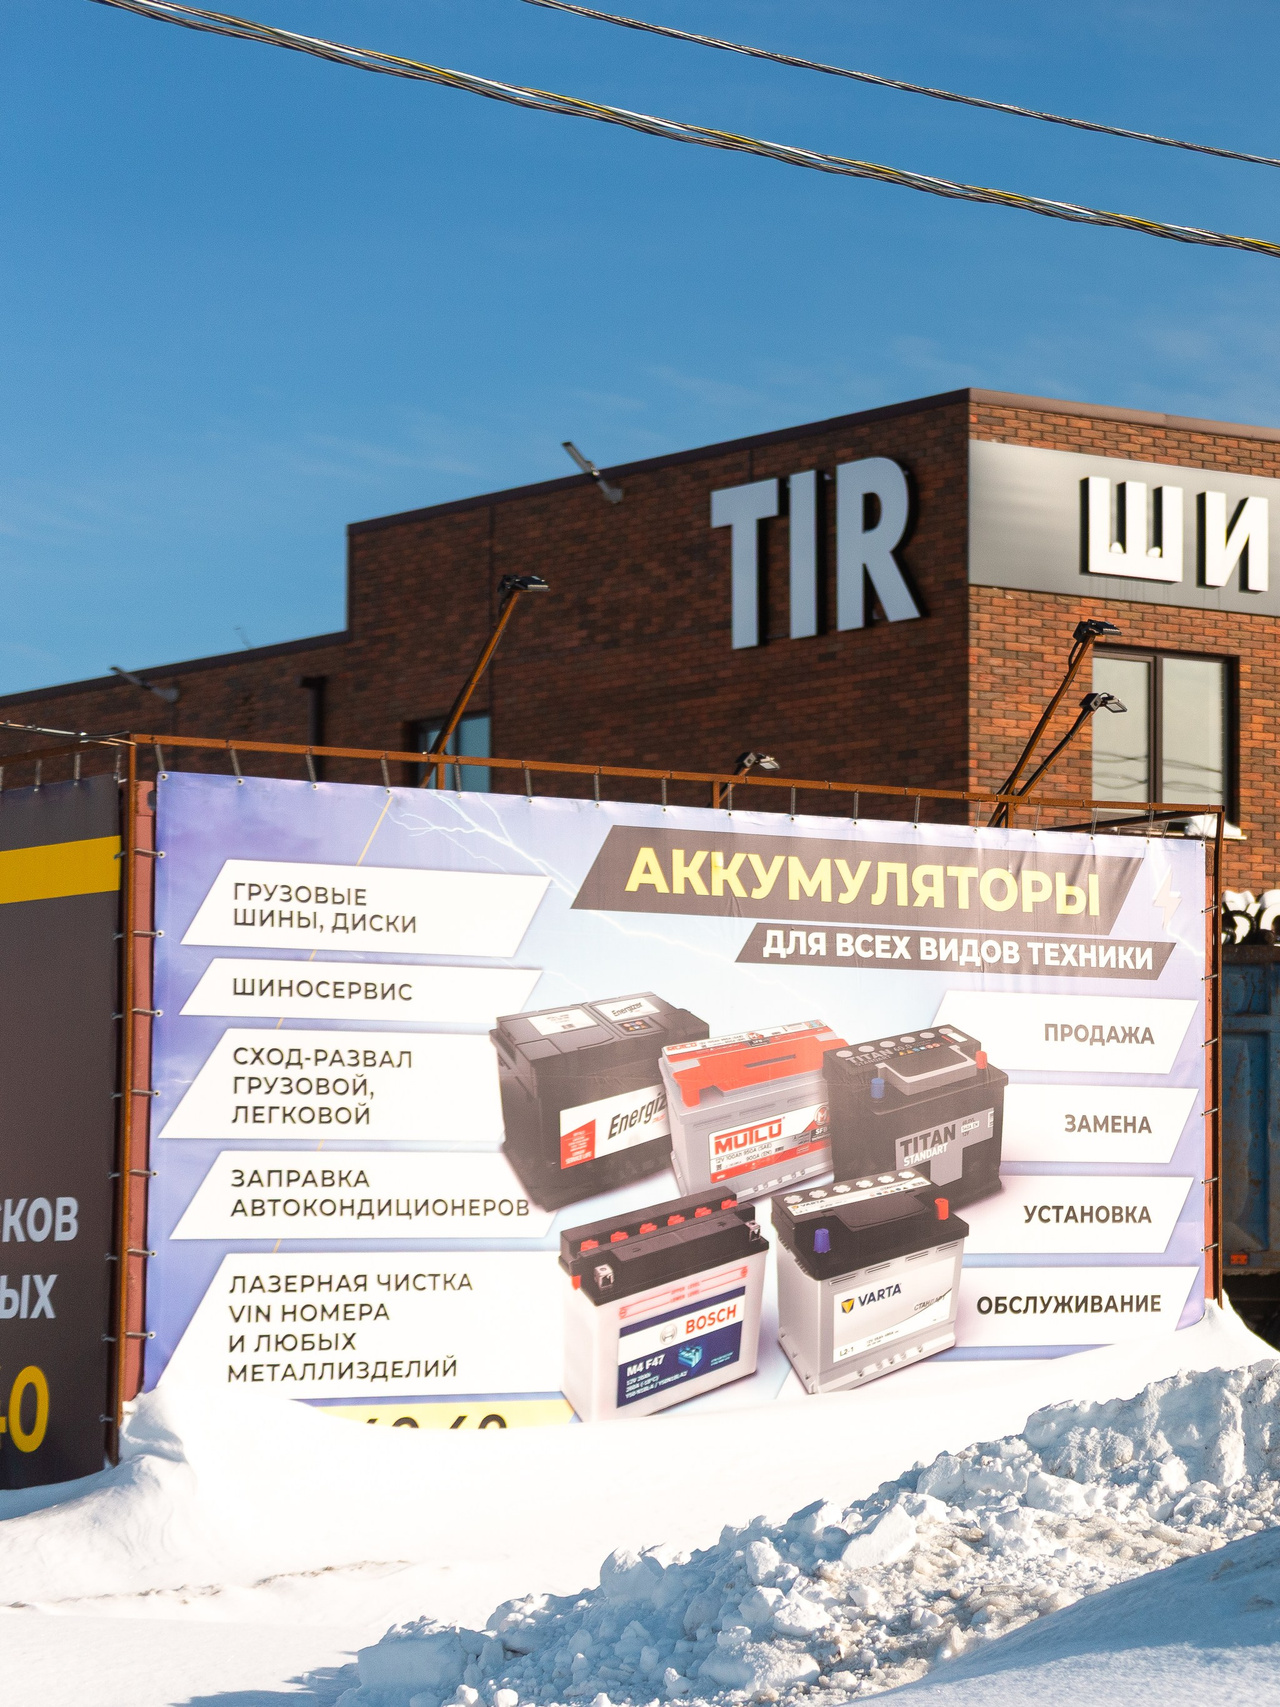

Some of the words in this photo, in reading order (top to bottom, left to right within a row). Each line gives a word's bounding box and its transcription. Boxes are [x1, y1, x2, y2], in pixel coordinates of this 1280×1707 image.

[711, 456, 921, 650] TIR
[233, 882, 367, 906] ГРУЗОВЫЕ
[624, 847, 1100, 917] АККУМУЛЯТОРЫ
[233, 908, 325, 934] ШИНЫ,
[331, 912, 417, 936] ДИСКИ
[763, 930, 826, 957] ДЛЯ
[836, 933, 911, 960] ВСЕХ
[920, 938, 1020, 967] ВИДОВ
[1027, 942, 1154, 970] ТЕХНИКИ
[233, 976, 413, 1002] ШИНОСЕРВИС
[611, 1002, 643, 1017] Energizer
[1044, 1022, 1155, 1047] ПРОДАЖА
[233, 1045, 413, 1070] СХОД-РАЗВАЛ
[233, 1073, 374, 1100] ГРУЗОВОЙ,
[232, 1100, 370, 1126] ЛЕГКОВОЙ
[1064, 1113, 1153, 1135] ЗАМЕНА
[714, 1117, 782, 1155] MUTLU
[900, 1124, 956, 1157] TITAN
[903, 1143, 948, 1167] STANDART
[231, 1169, 370, 1188] ЗАПРАВКА
[0, 1196, 79, 1243] КОВ
[231, 1195, 530, 1219] АВТОКОНДИЦИОНЕРОВ
[1023, 1204, 1152, 1226] УСТАНОВКА
[229, 1274, 368, 1294] ЛАЗЕРНАЯ
[376, 1273, 473, 1292] ЧИСТКА
[858, 1284, 901, 1307] VARTA
[228, 1304, 271, 1324] VIN
[281, 1303, 390, 1323] НОМЕРА
[976, 1294, 1162, 1317] ОБСЛУЖИВАНИЕ
[686, 1304, 737, 1334] BOSCH
[229, 1334, 245, 1353] И
[253, 1332, 357, 1353] ЛЮБЫХ
[228, 1355, 458, 1383] МЕТАЛЛИЗДЕЛИЙ
[626, 1362, 644, 1377] M4
[0, 1365, 49, 1453] 0
